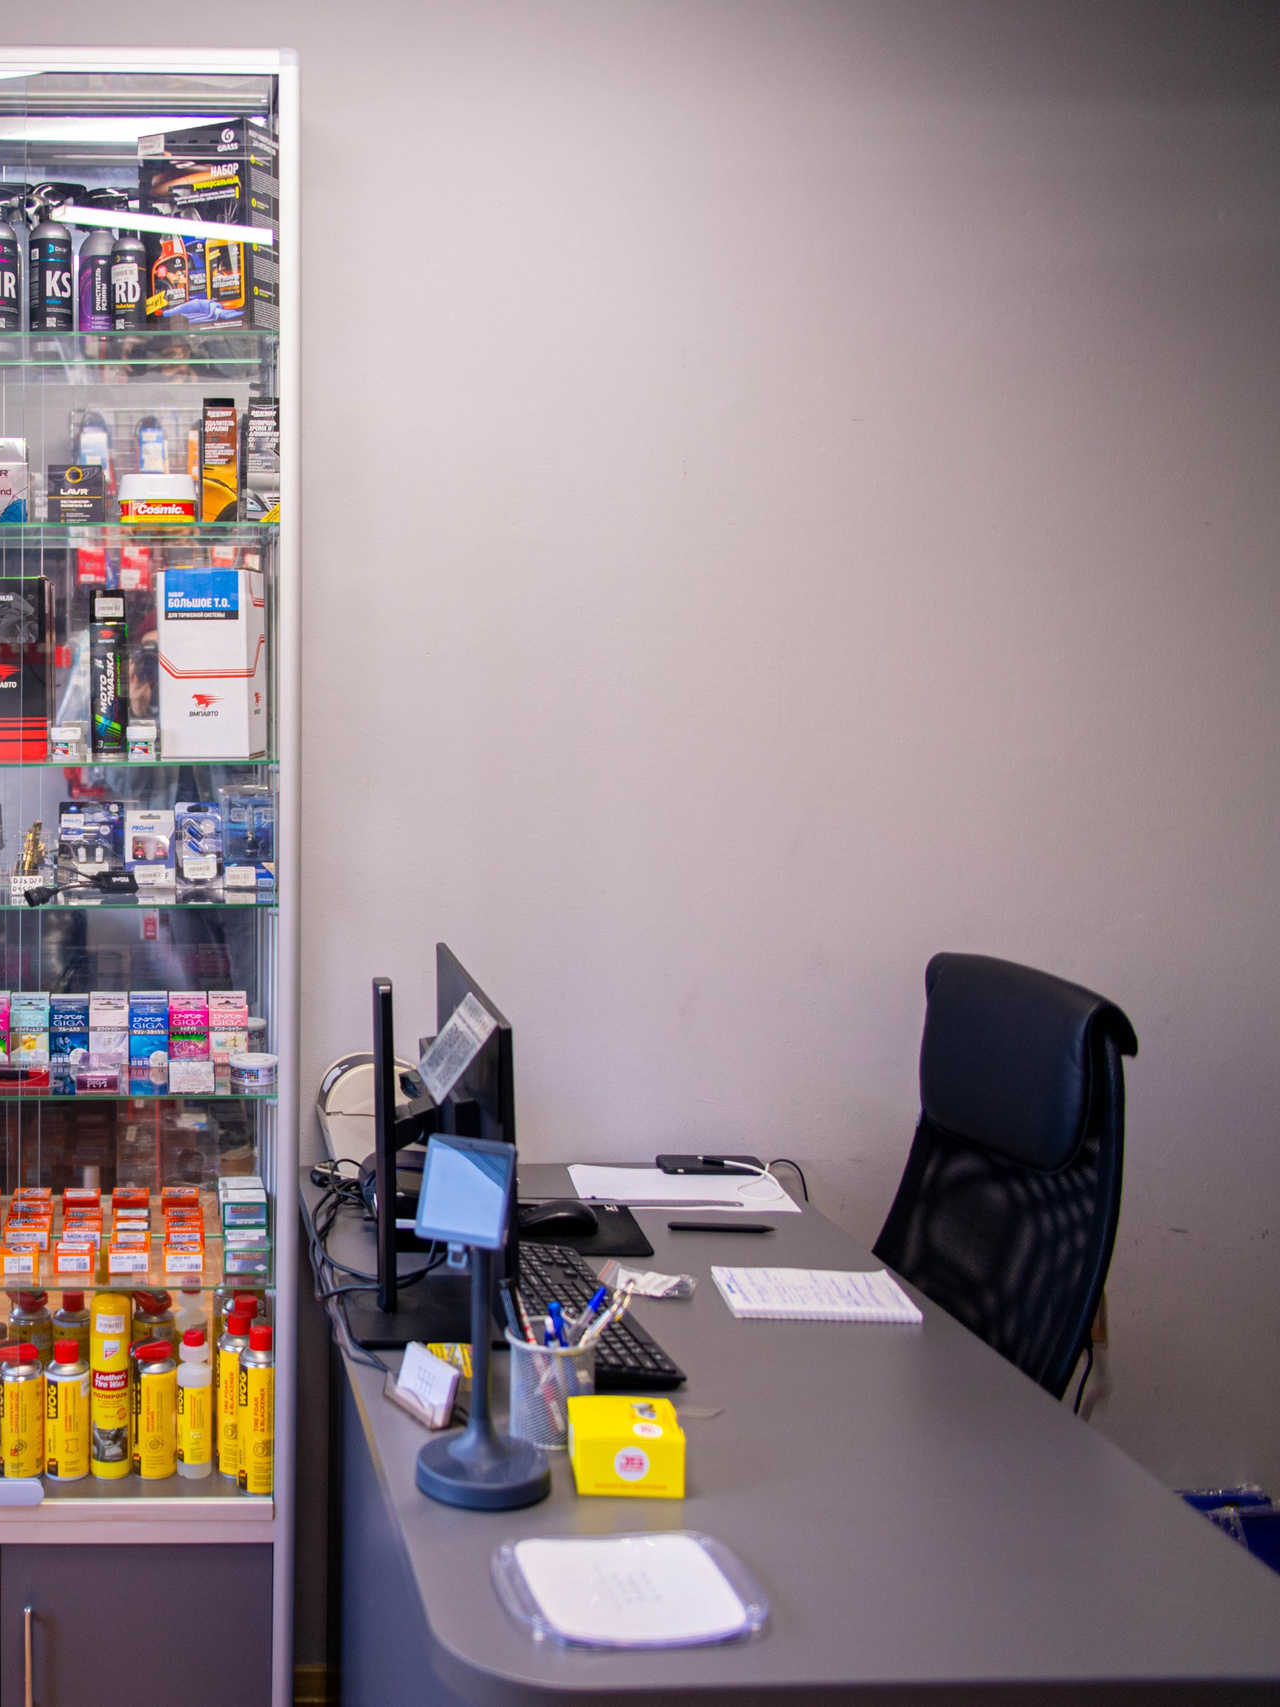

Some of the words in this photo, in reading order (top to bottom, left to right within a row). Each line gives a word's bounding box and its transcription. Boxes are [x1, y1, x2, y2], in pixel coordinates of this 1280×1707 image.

[217, 142, 239, 153] GRASS
[210, 162, 240, 178] НАБОР
[193, 175, 240, 191] универсальный
[45, 269, 72, 299] KS
[115, 280, 141, 303] RD
[59, 488, 89, 496] LAVR
[167, 597, 212, 609] БОЛЬШОЕ
[213, 597, 231, 609] Т.О.
[99, 673, 108, 714] МОТО
[188, 710, 219, 718] ВМПАВТО
[132, 1022, 165, 1030] GIGA
[94, 1379, 109, 1388] Tire
[110, 1379, 126, 1389] Wax
[239, 1371, 248, 1406] WOG
[47, 1385, 58, 1419] WOG
